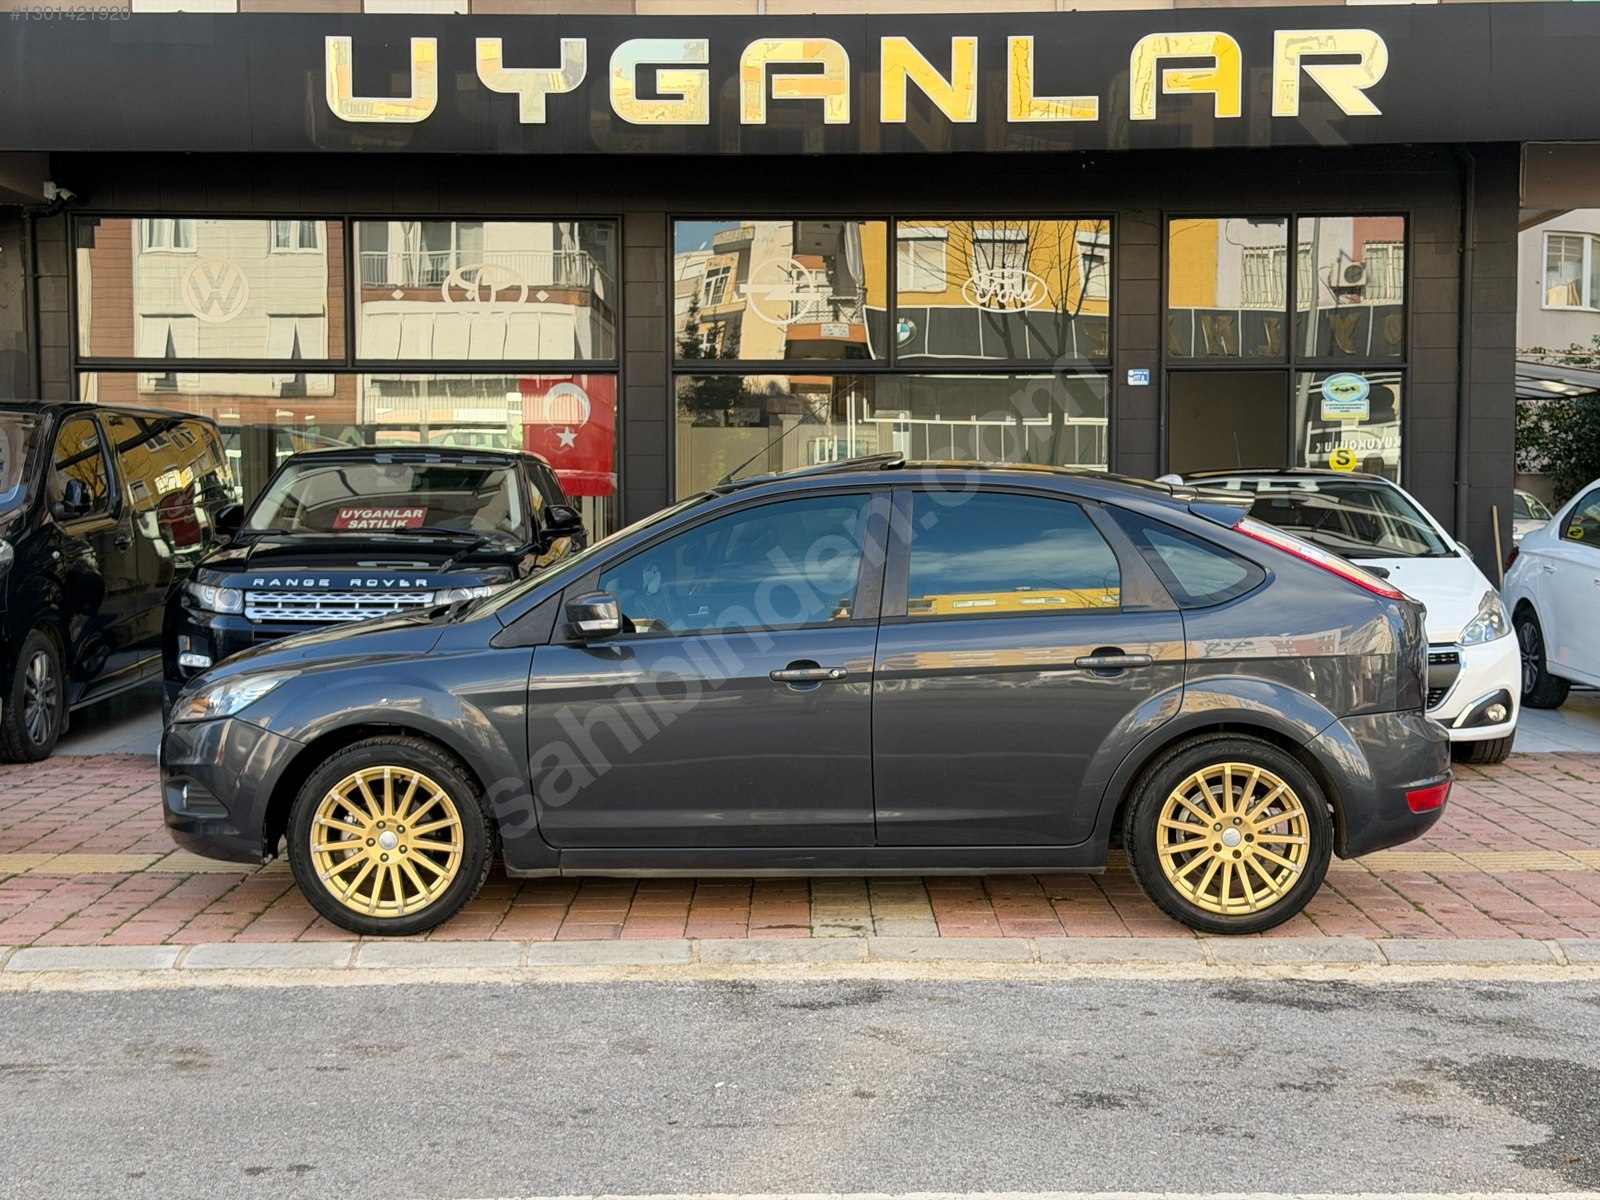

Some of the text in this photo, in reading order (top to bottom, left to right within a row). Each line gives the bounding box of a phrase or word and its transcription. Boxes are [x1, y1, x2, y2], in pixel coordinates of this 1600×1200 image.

[324, 28, 1390, 126] UYGANLAR
[1336, 450, 1350, 465] S
[341, 509, 423, 519] UYGANLAR
[347, 519, 408, 529] SATILIK
[252, 578, 427, 587] RANGE ROVER
